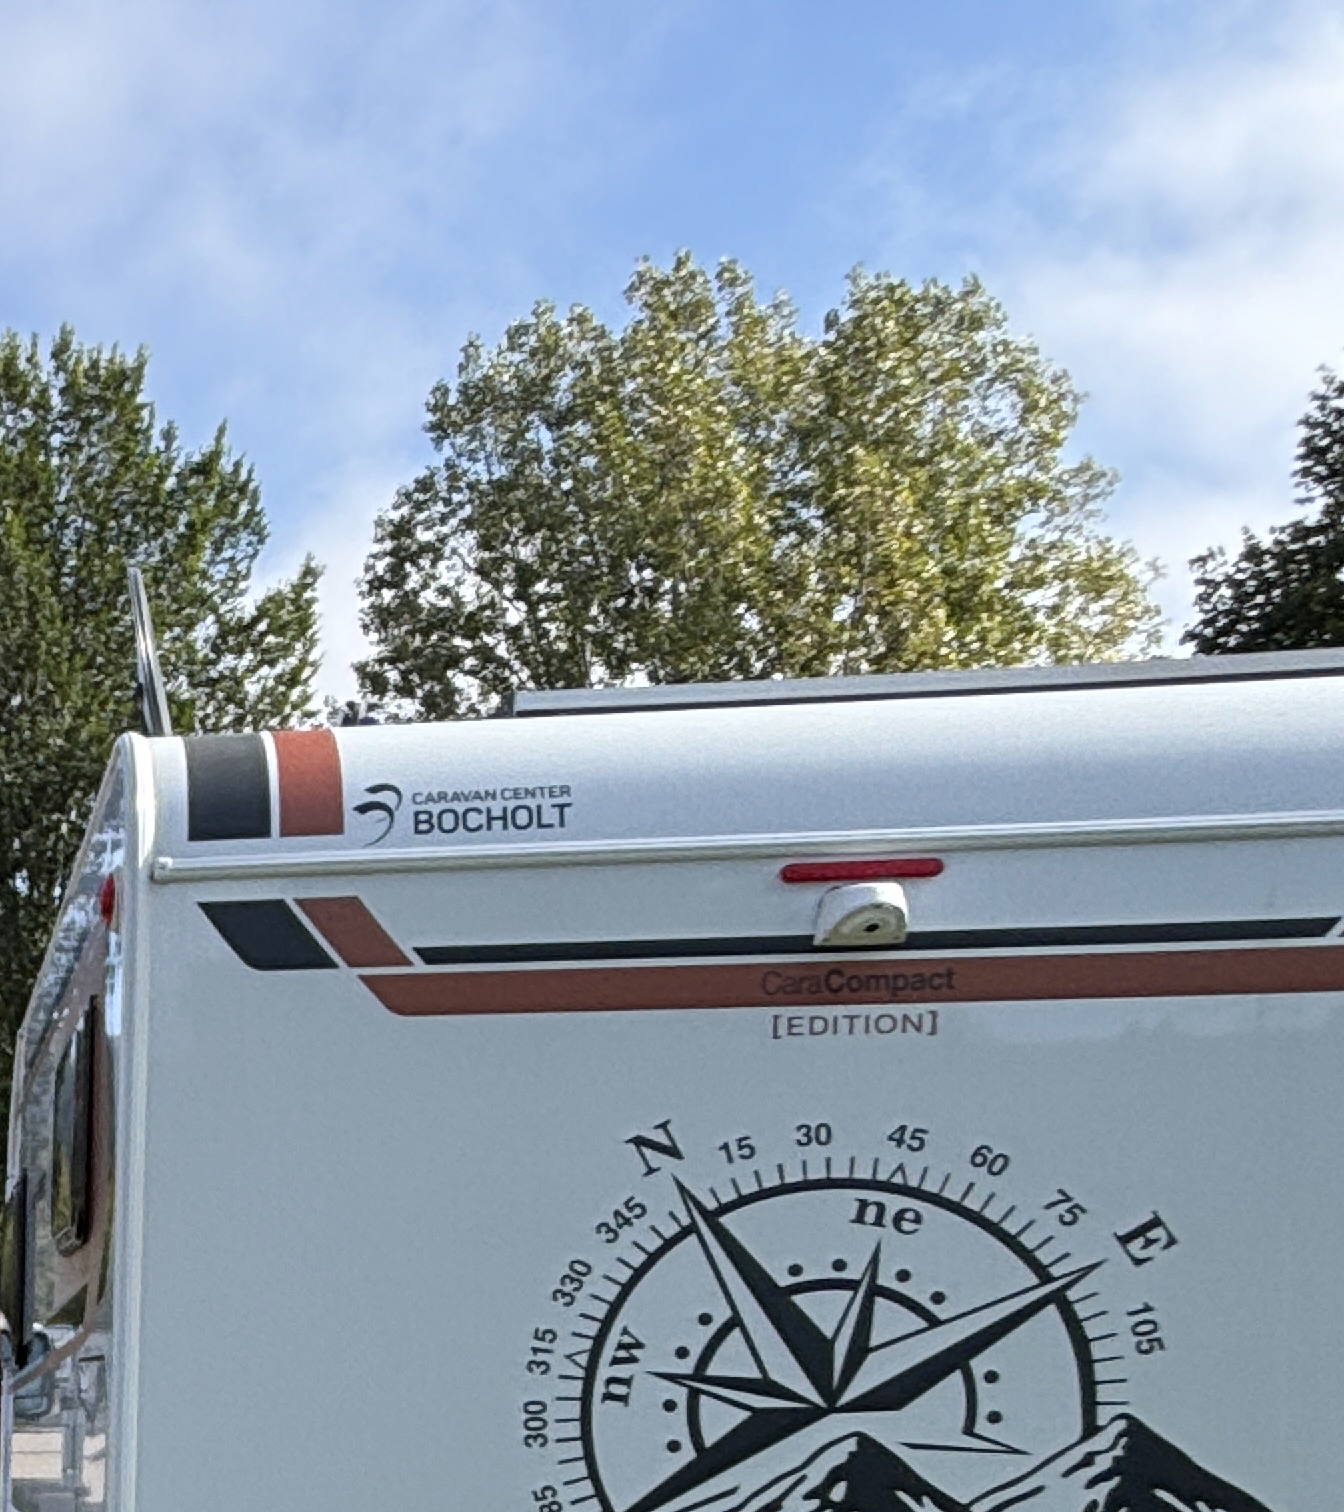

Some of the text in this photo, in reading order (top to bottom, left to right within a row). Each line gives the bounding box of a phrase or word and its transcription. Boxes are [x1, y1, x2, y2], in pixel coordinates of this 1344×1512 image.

[412, 785, 571, 805] CARAVAN CENTER
[414, 803, 573, 834] BOCHOLT
[762, 967, 956, 996] CaraCompact
[624, 1119, 685, 1177] N
[718, 1136, 756, 1164] 15
[795, 1122, 833, 1146] 30
[886, 1124, 929, 1152] 45
[970, 1144, 1010, 1177] 60
[595, 1196, 648, 1244] 345
[849, 1197, 924, 1235] ne
[1043, 1188, 1087, 1226] 75
[1114, 1210, 1179, 1267] E
[552, 1258, 593, 1308] 330
[1126, 1302, 1166, 1355] 105
[526, 1327, 558, 1376] 315
[601, 1325, 646, 1407] nw
[523, 1399, 548, 1448] 300
